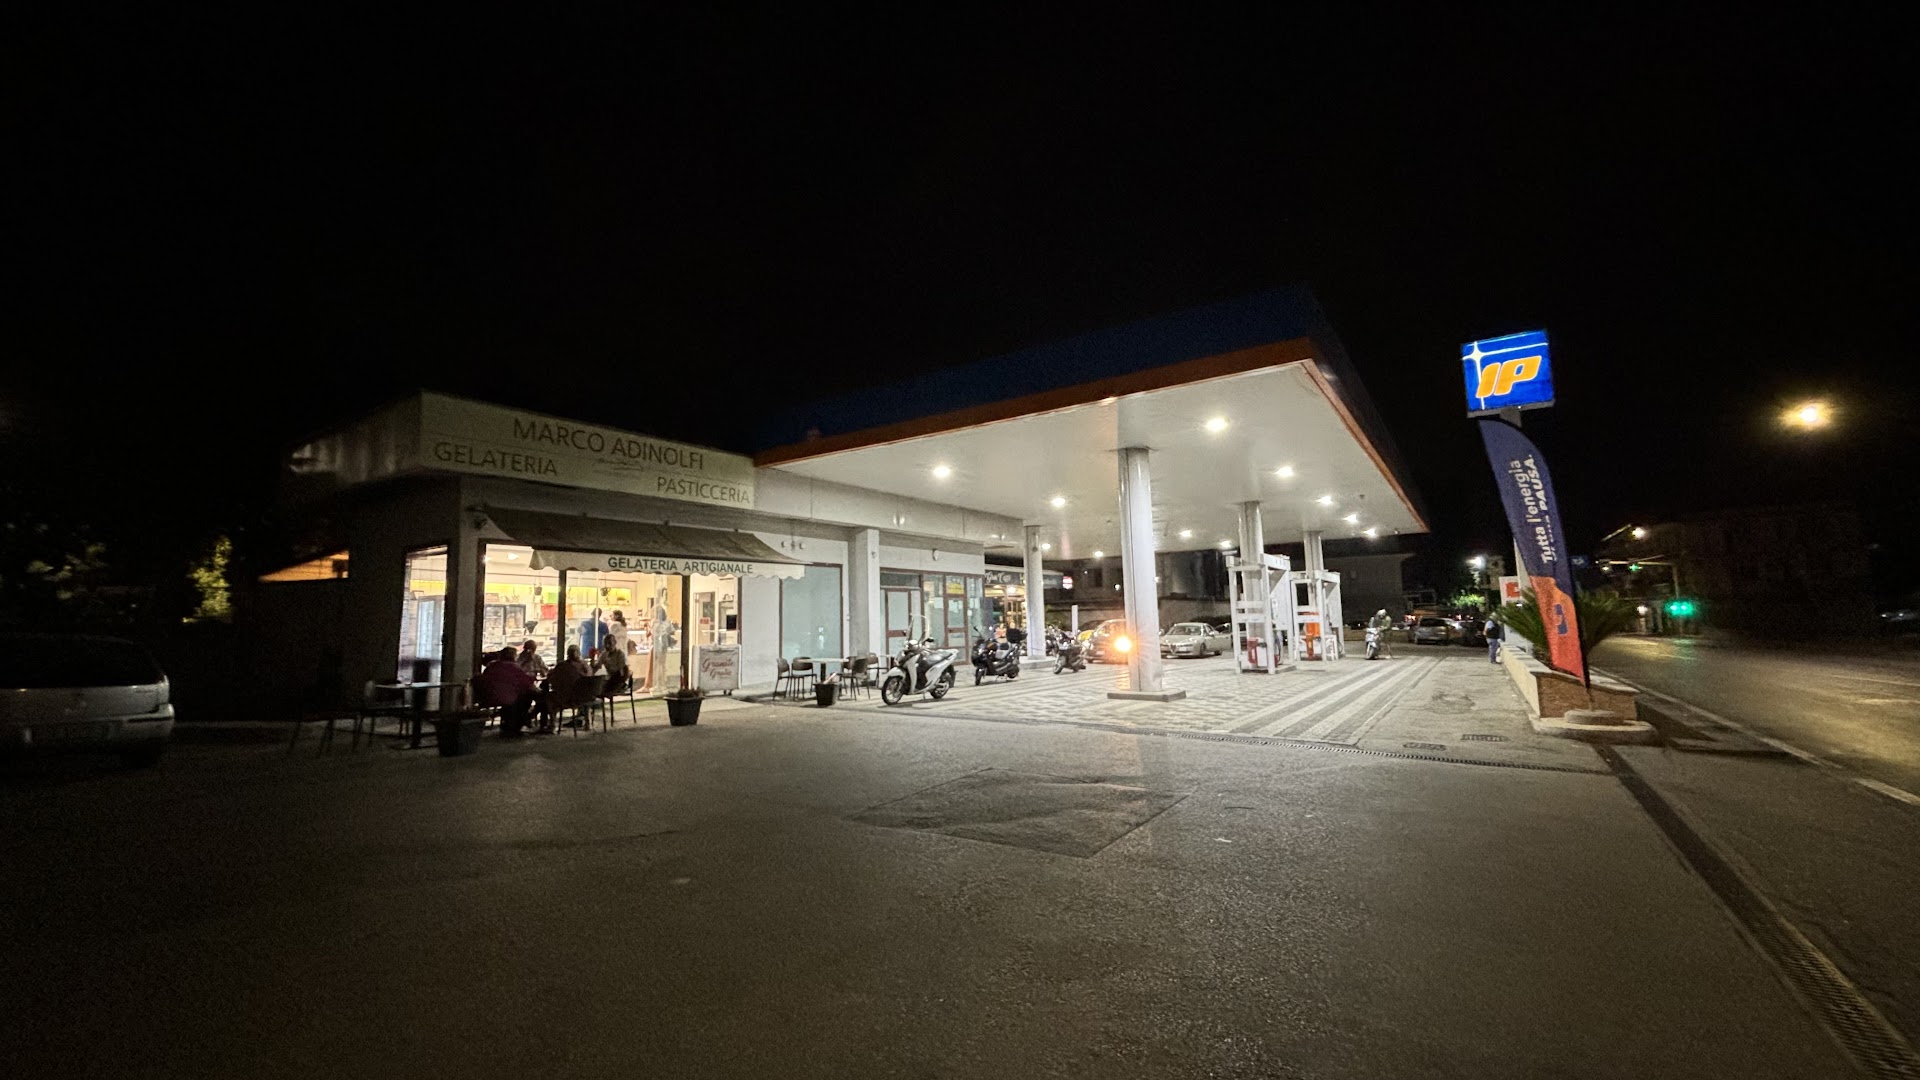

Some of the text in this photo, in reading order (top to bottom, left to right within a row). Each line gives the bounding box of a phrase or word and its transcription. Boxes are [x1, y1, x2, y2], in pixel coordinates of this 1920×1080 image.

[434, 441, 558, 477] GELATERIA
[513, 418, 606, 453] MARCO
[611, 437, 703, 470] ADINOLFI
[656, 476, 750, 504] PASTICCERIA
[1508, 460, 1542, 523] l'energia
[1523, 454, 1548, 511] PAUSA.
[1535, 526, 1553, 563] Tutta
[607, 556, 754, 574] GELATERIA ARTIGIANALE
